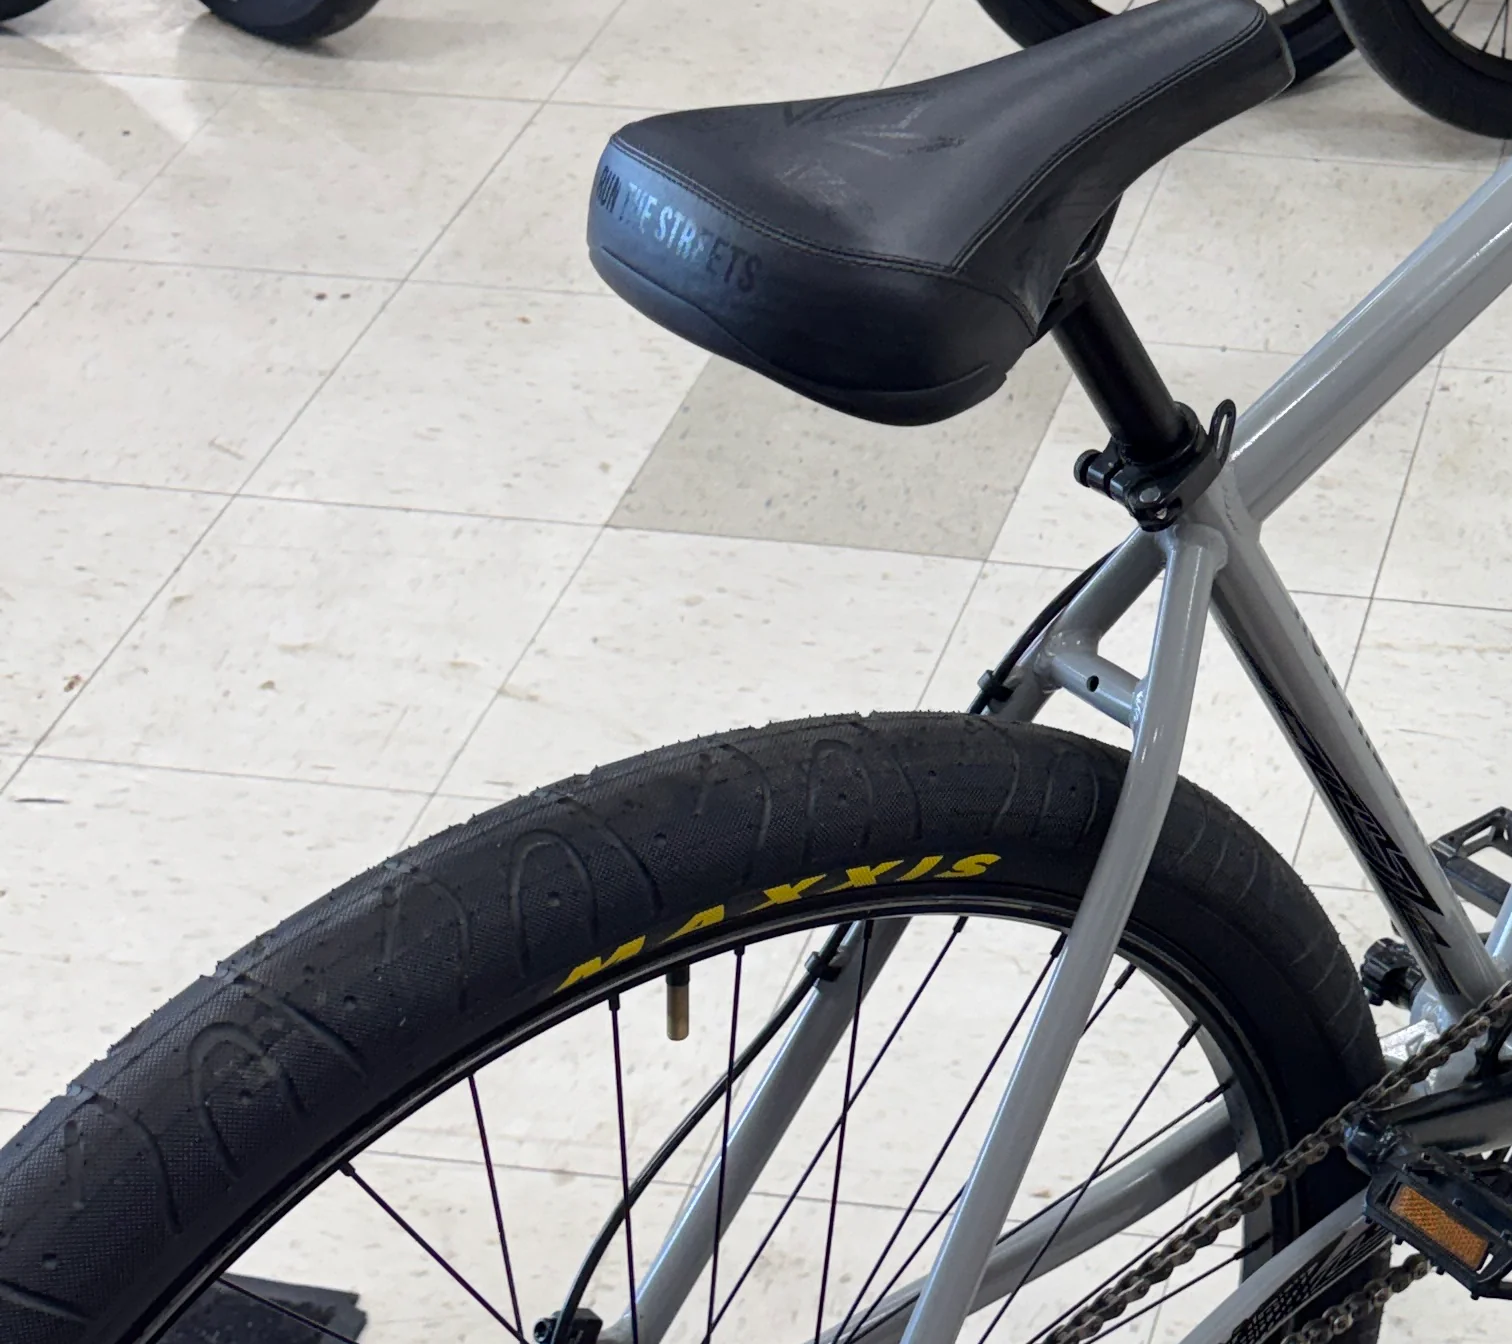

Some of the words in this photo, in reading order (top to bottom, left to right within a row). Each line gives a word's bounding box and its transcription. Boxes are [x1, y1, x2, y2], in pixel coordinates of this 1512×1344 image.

[619, 181, 658, 235] THE
[655, 206, 763, 294] STREETS
[554, 852, 1001, 994] MAXXIS
